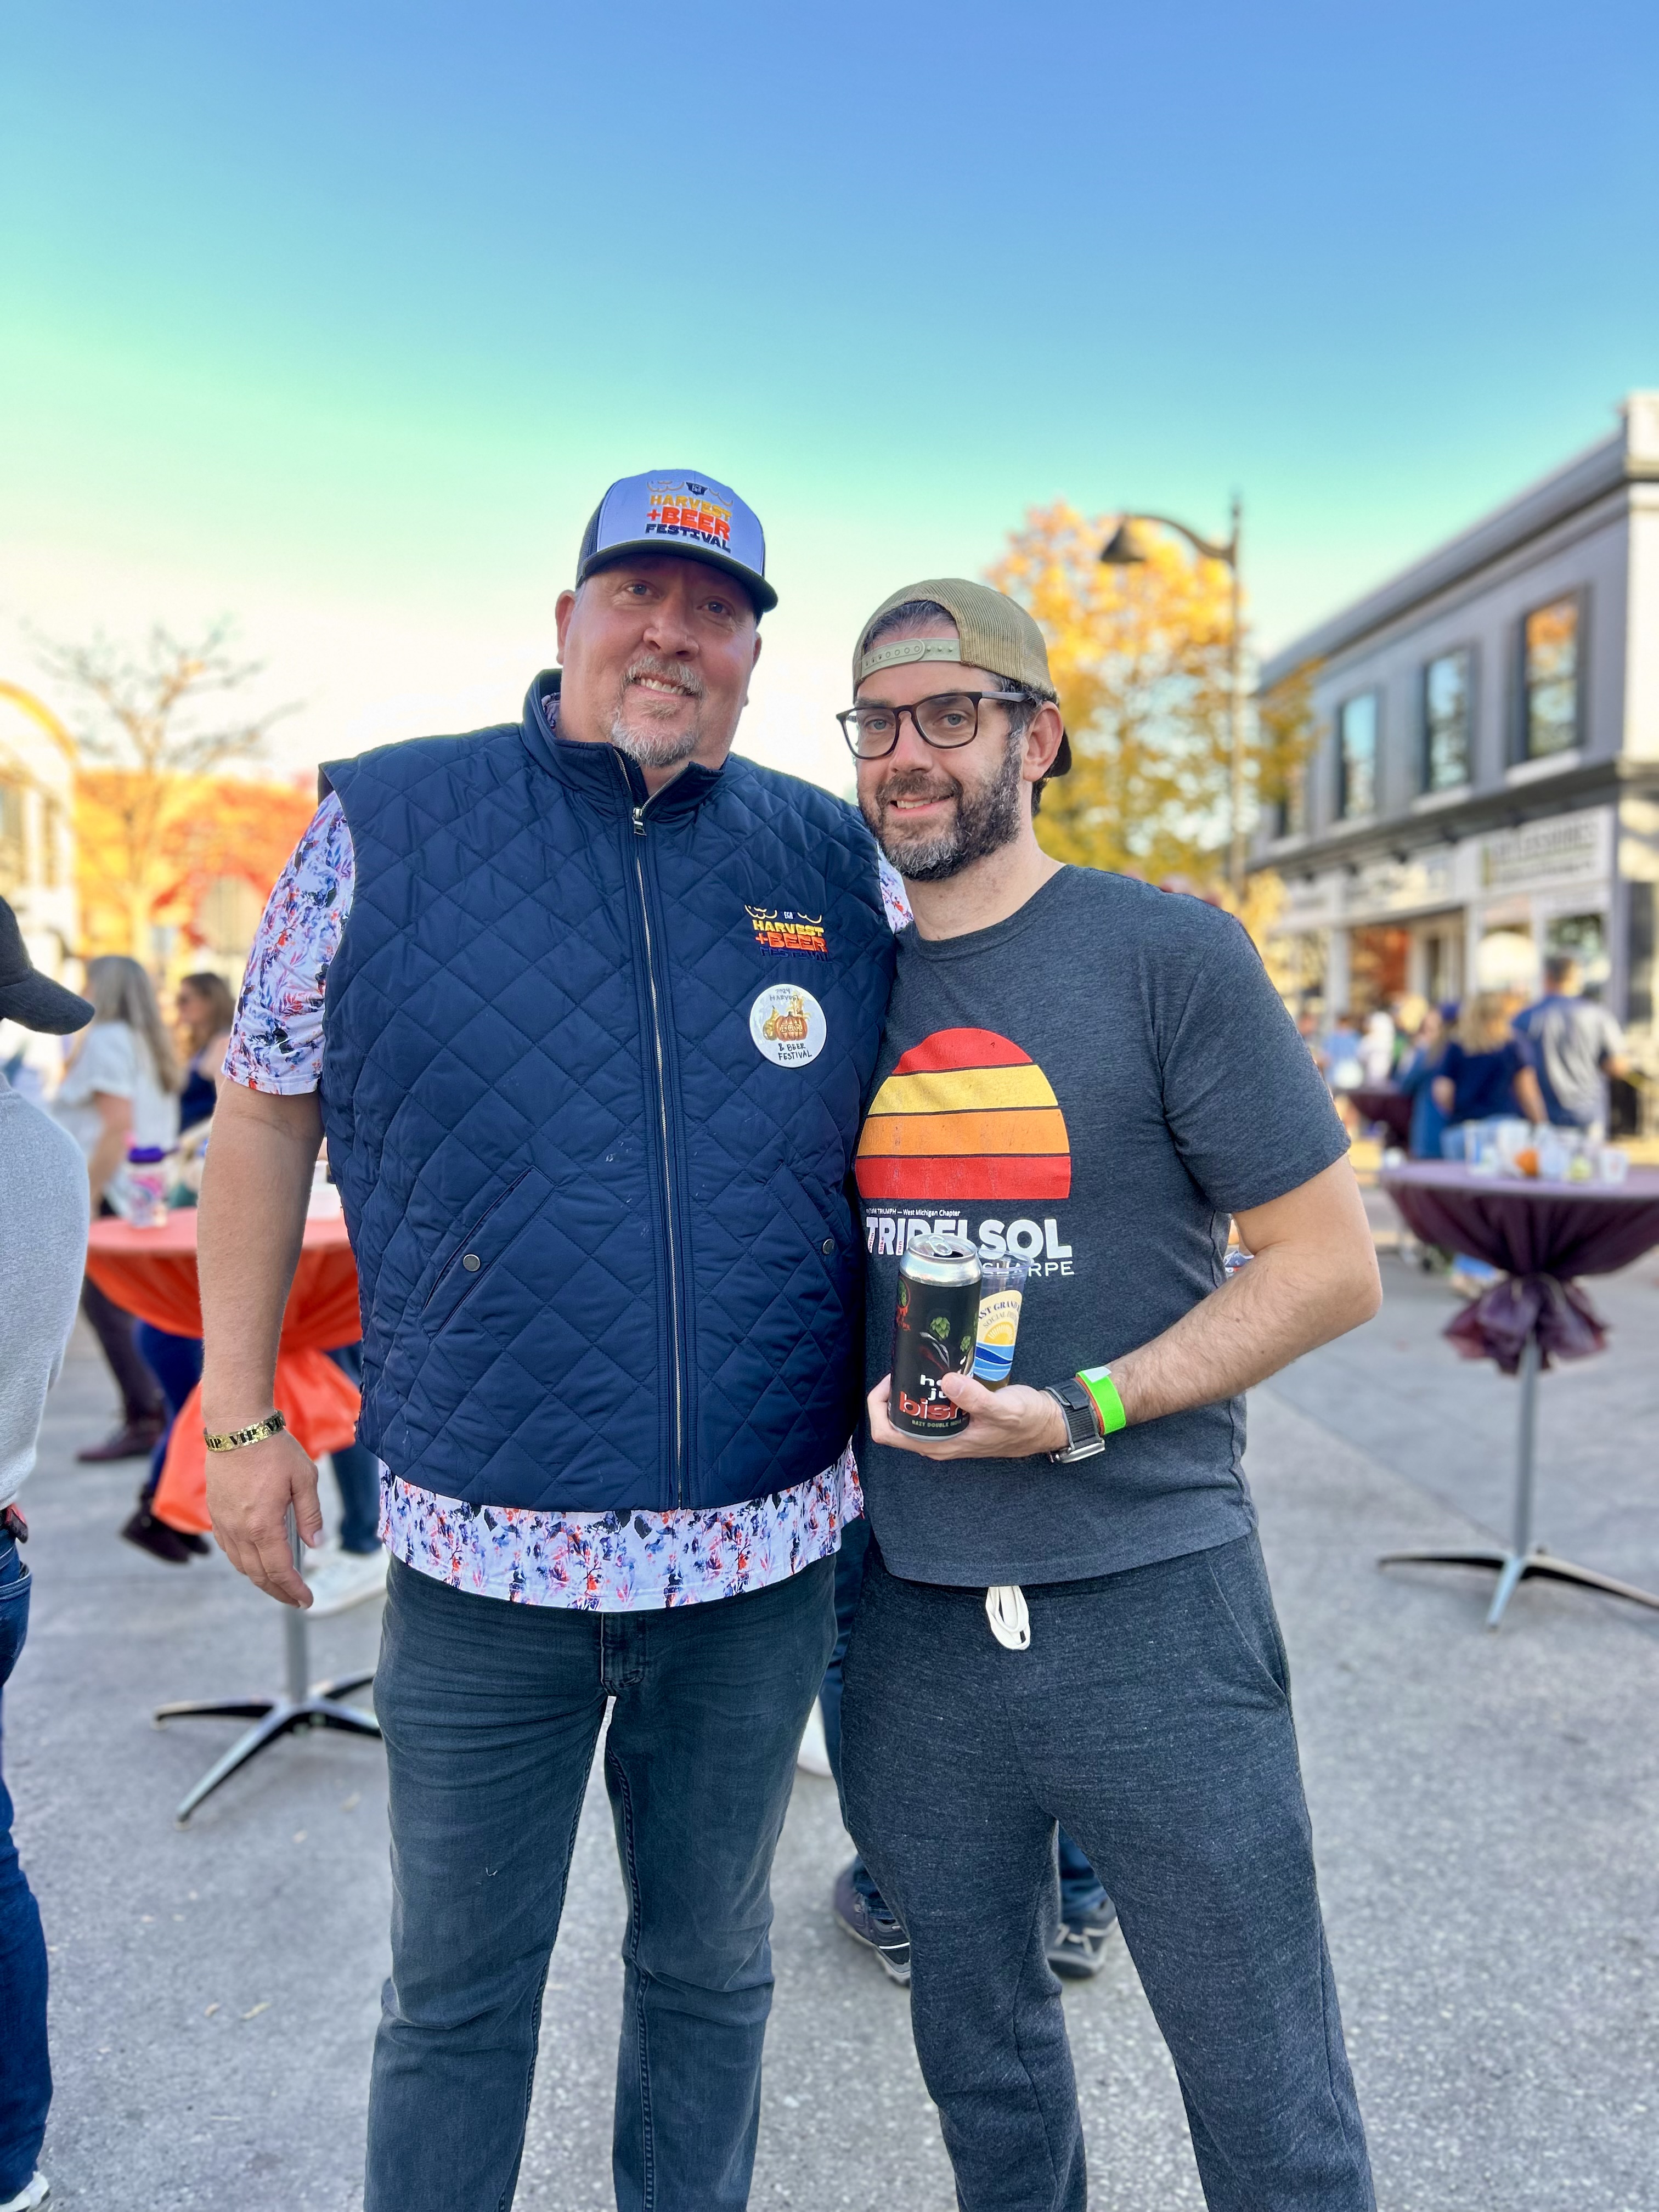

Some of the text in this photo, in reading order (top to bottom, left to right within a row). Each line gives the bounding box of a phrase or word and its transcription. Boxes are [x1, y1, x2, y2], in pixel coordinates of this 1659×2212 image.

[650, 494, 732, 521] HARVEST
[645, 523, 731, 554] FESTIVAL
[752, 919, 825, 936] HARVEST
[780, 1024, 803, 1032] EGR
[778, 1049, 812, 1060] FESTIVAL
[786, 1042, 806, 1052] BEER
[915, 1209, 938, 1217] Michigan
[939, 1209, 961, 1218] Chapter
[978, 1218, 1073, 1260] SOL
[229, 1428, 258, 1446] VIP
